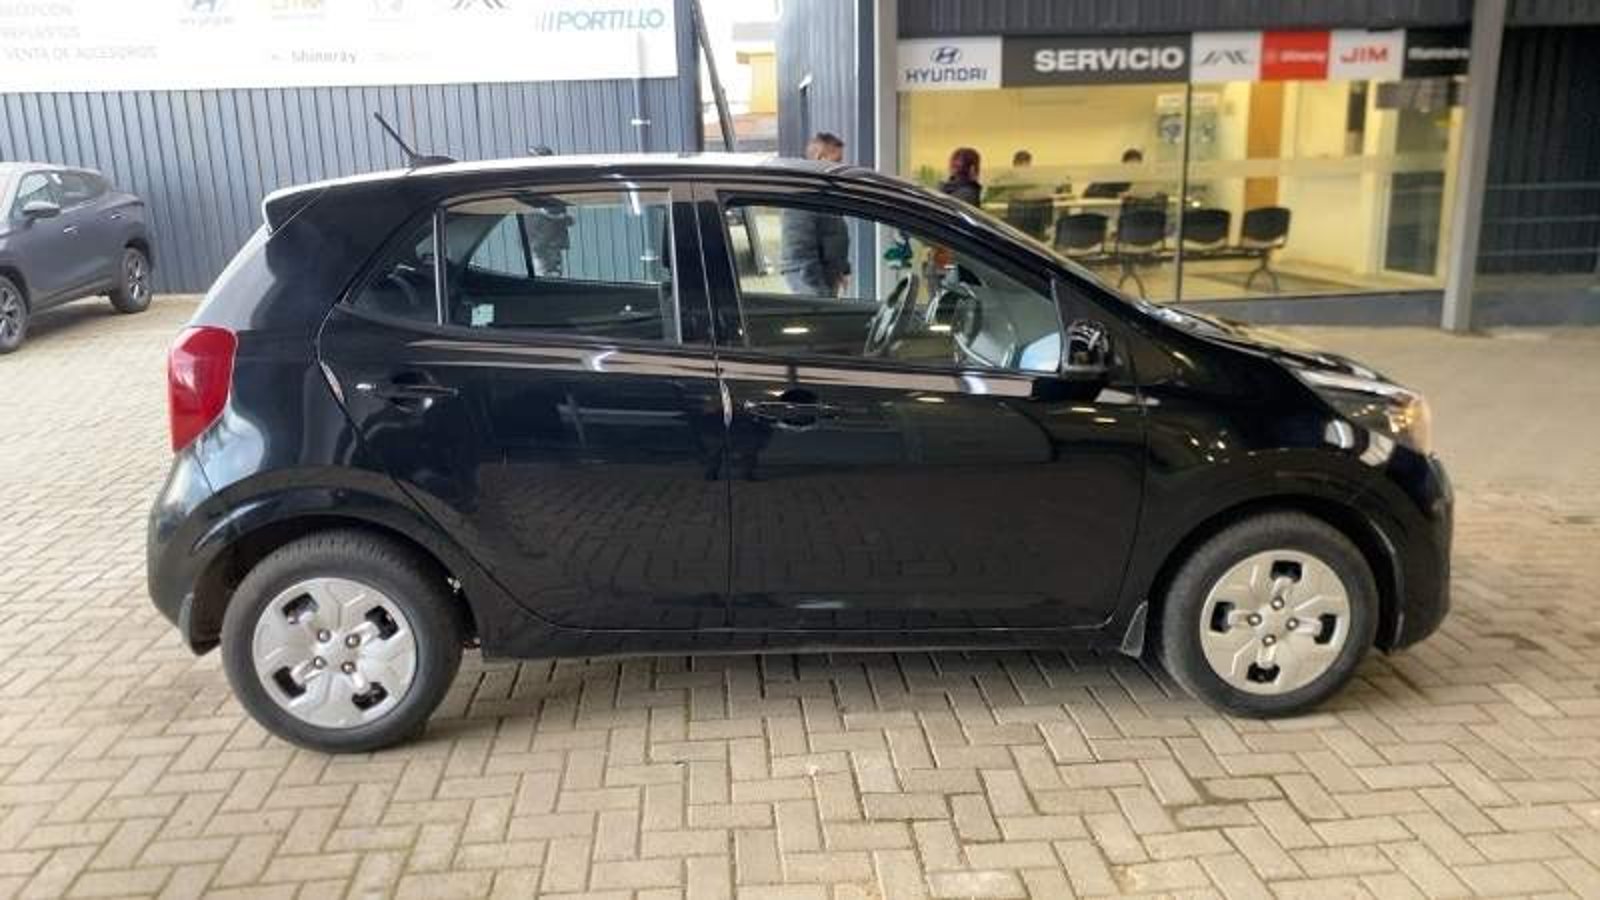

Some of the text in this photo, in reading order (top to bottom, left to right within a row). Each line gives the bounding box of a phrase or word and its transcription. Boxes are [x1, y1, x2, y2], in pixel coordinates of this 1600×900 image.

[556, 8, 665, 31] PORTILLO
[1033, 46, 1185, 72] SERVICIO
[1340, 48, 1388, 63] JIM
[905, 66, 988, 83] HYUNDAI
